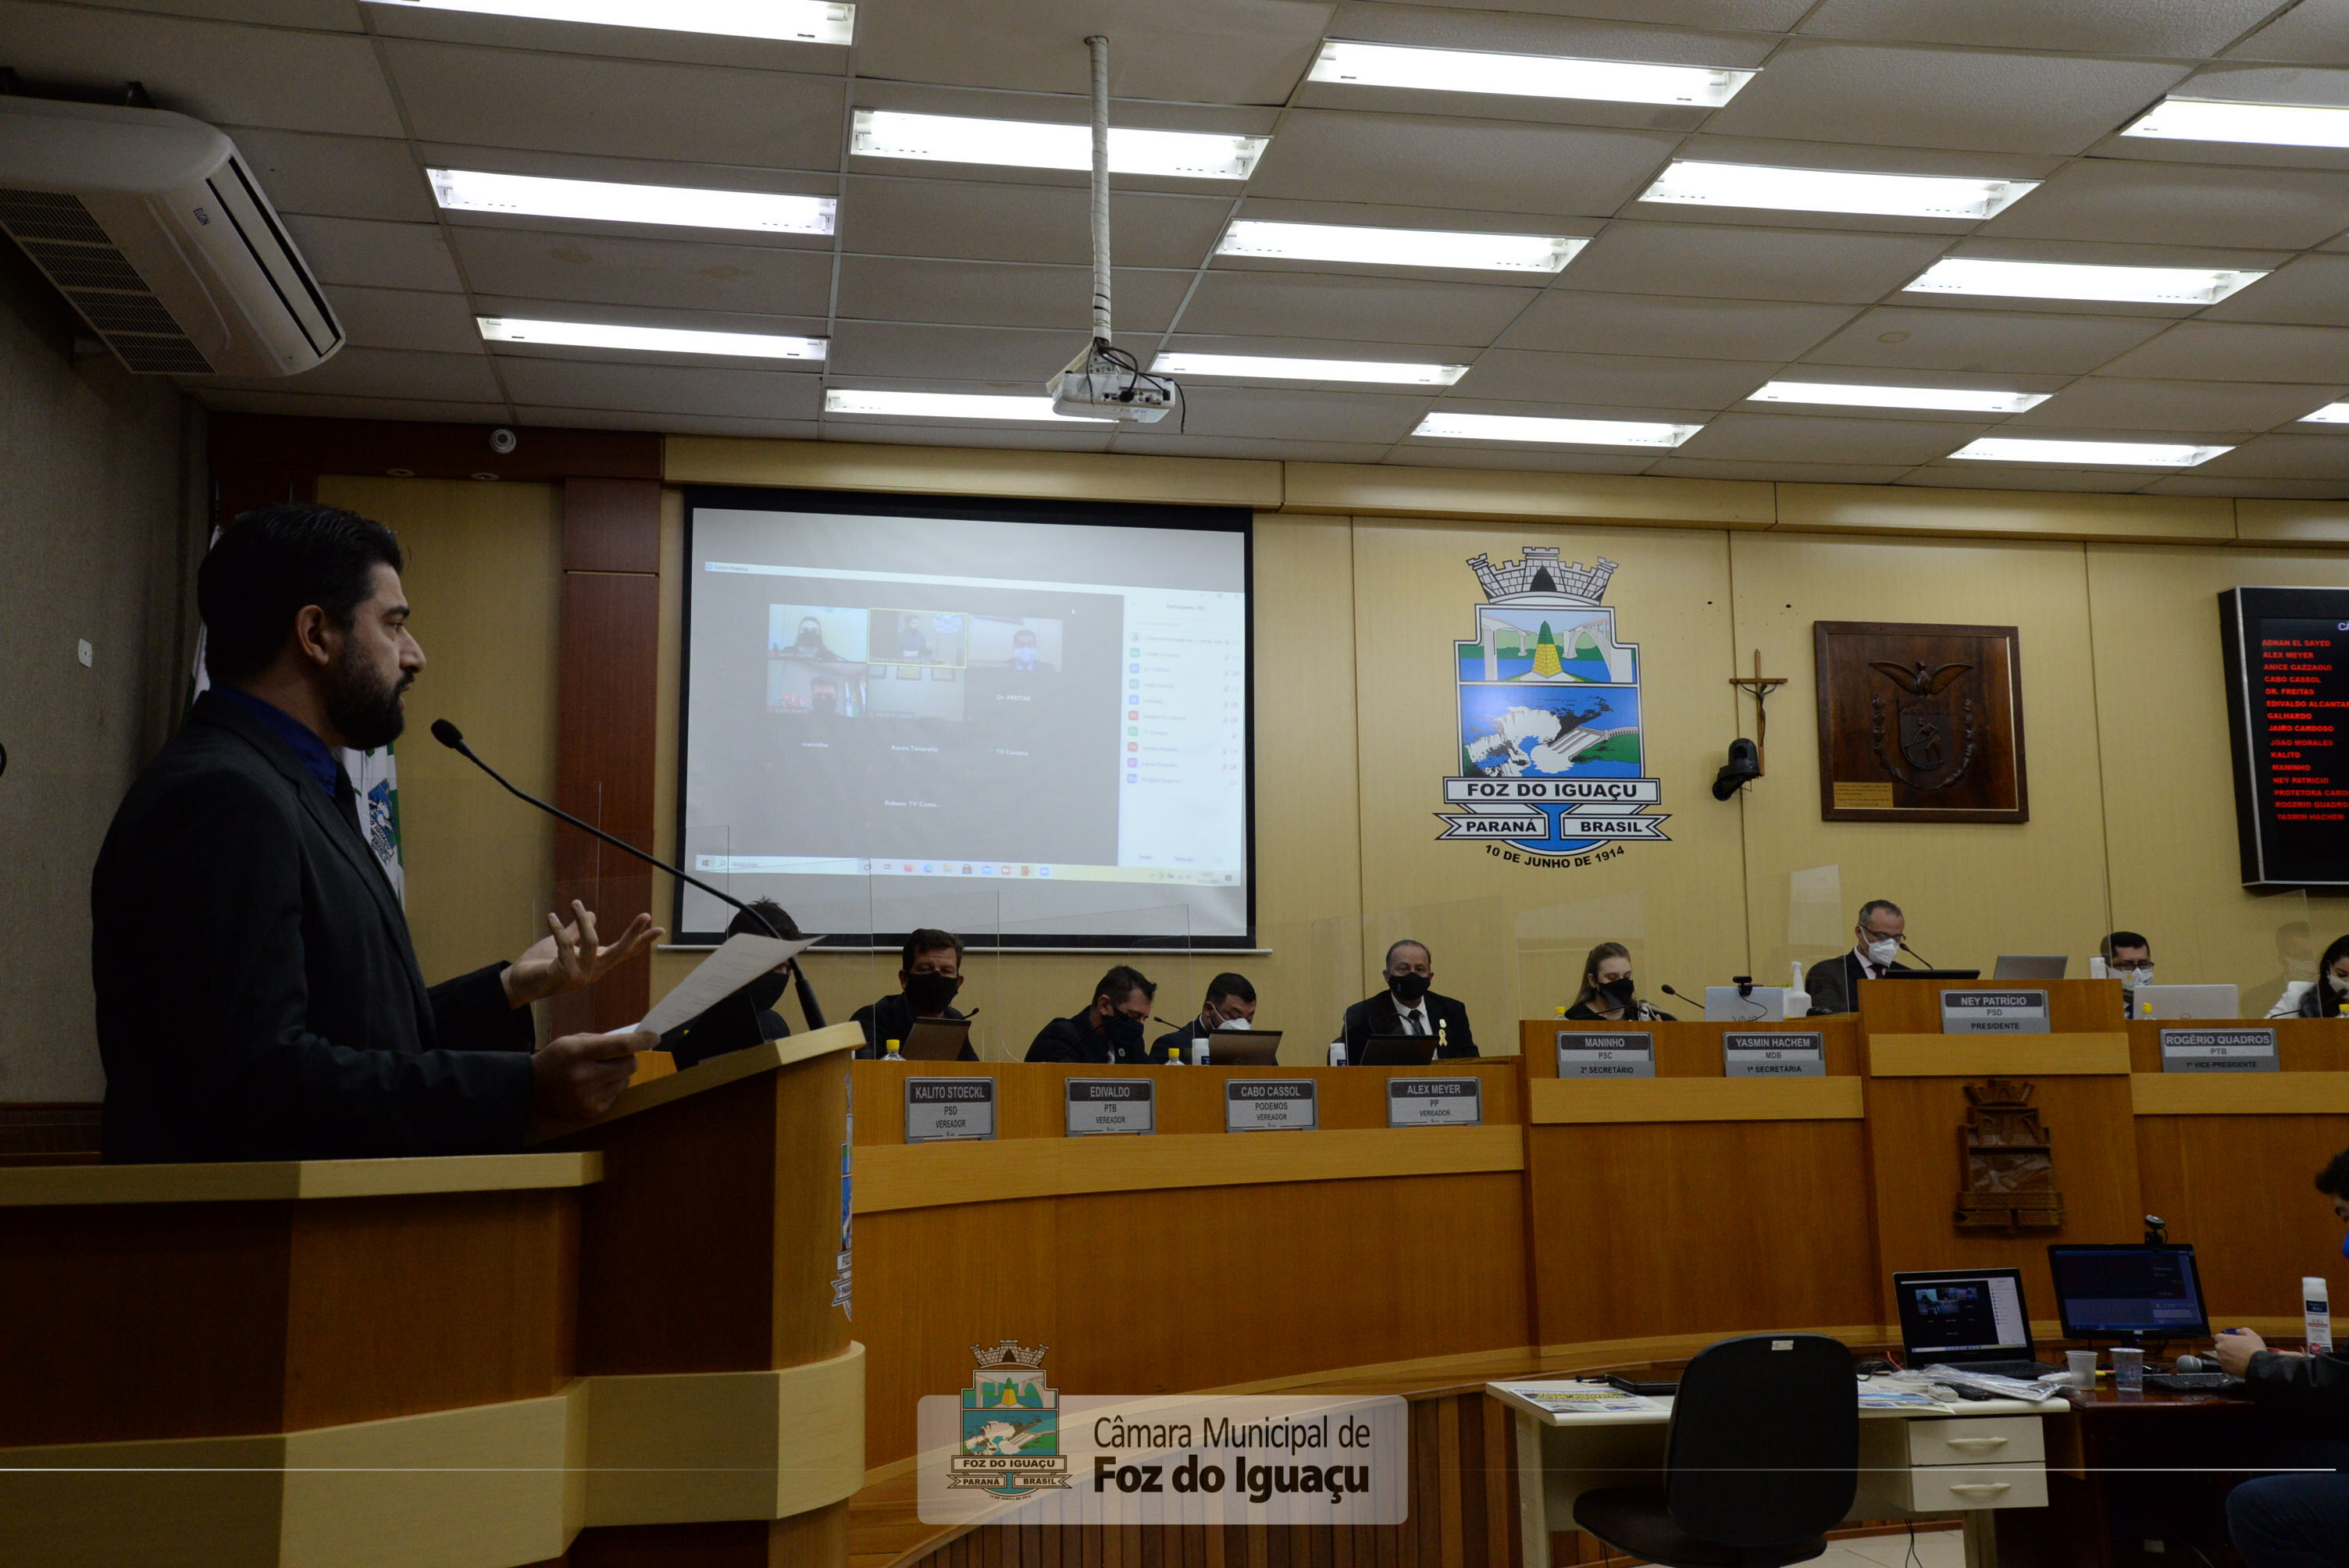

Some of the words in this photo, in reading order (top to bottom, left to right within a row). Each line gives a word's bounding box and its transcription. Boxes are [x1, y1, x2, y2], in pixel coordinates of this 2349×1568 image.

[1467, 783, 1510, 797] FOZ
[1517, 783, 1547, 797] DO
[1555, 783, 1638, 800] IGUAÇU
[1466, 819, 1537, 832] PARANÁ
[1580, 821, 1643, 832] BRASIL
[1485, 844, 1500, 857] 10
[1503, 850, 1520, 864] DE
[1524, 857, 1573, 868] JUNHO
[1574, 856, 1592, 867] DE
[1595, 846, 1625, 863] 1914
[1961, 996, 1980, 1007] NEY
[1983, 995, 2027, 1007] PATRÍCIO
[1584, 1038, 1625, 1048] MANINHO
[1735, 1038, 1770, 1048] YASMIN
[1771, 1038, 1811, 1048] HACHEM
[2166, 1034, 2215, 1045] ROGÉRIO
[2218, 1035, 2270, 1045] QUADROS
[1599, 1051, 1613, 1060] PSC
[1766, 1051, 1782, 1060] MDB
[1588, 1065, 1634, 1074] SECRETÁRIO
[1755, 1064, 1802, 1074] SECRETÁRIA
[915, 1086, 946, 1099] KALITO
[947, 1086, 985, 1099] STOECKL
[1090, 1086, 1130, 1098] EDIVALDO
[1241, 1086, 1266, 1097] CABO
[1267, 1086, 1301, 1097] CASSOL
[1407, 1085, 1430, 1095] ALEX
[1431, 1084, 1461, 1094] MEYER
[944, 1106, 957, 1115] PSD
[1103, 1103, 1117, 1113] PTB
[1255, 1102, 1288, 1111] PODEMOS
[1095, 1116, 1126, 1125] VEREADOR
[1256, 1113, 1288, 1121] VEREADOR
[936, 1119, 966, 1128] VEREADOR
